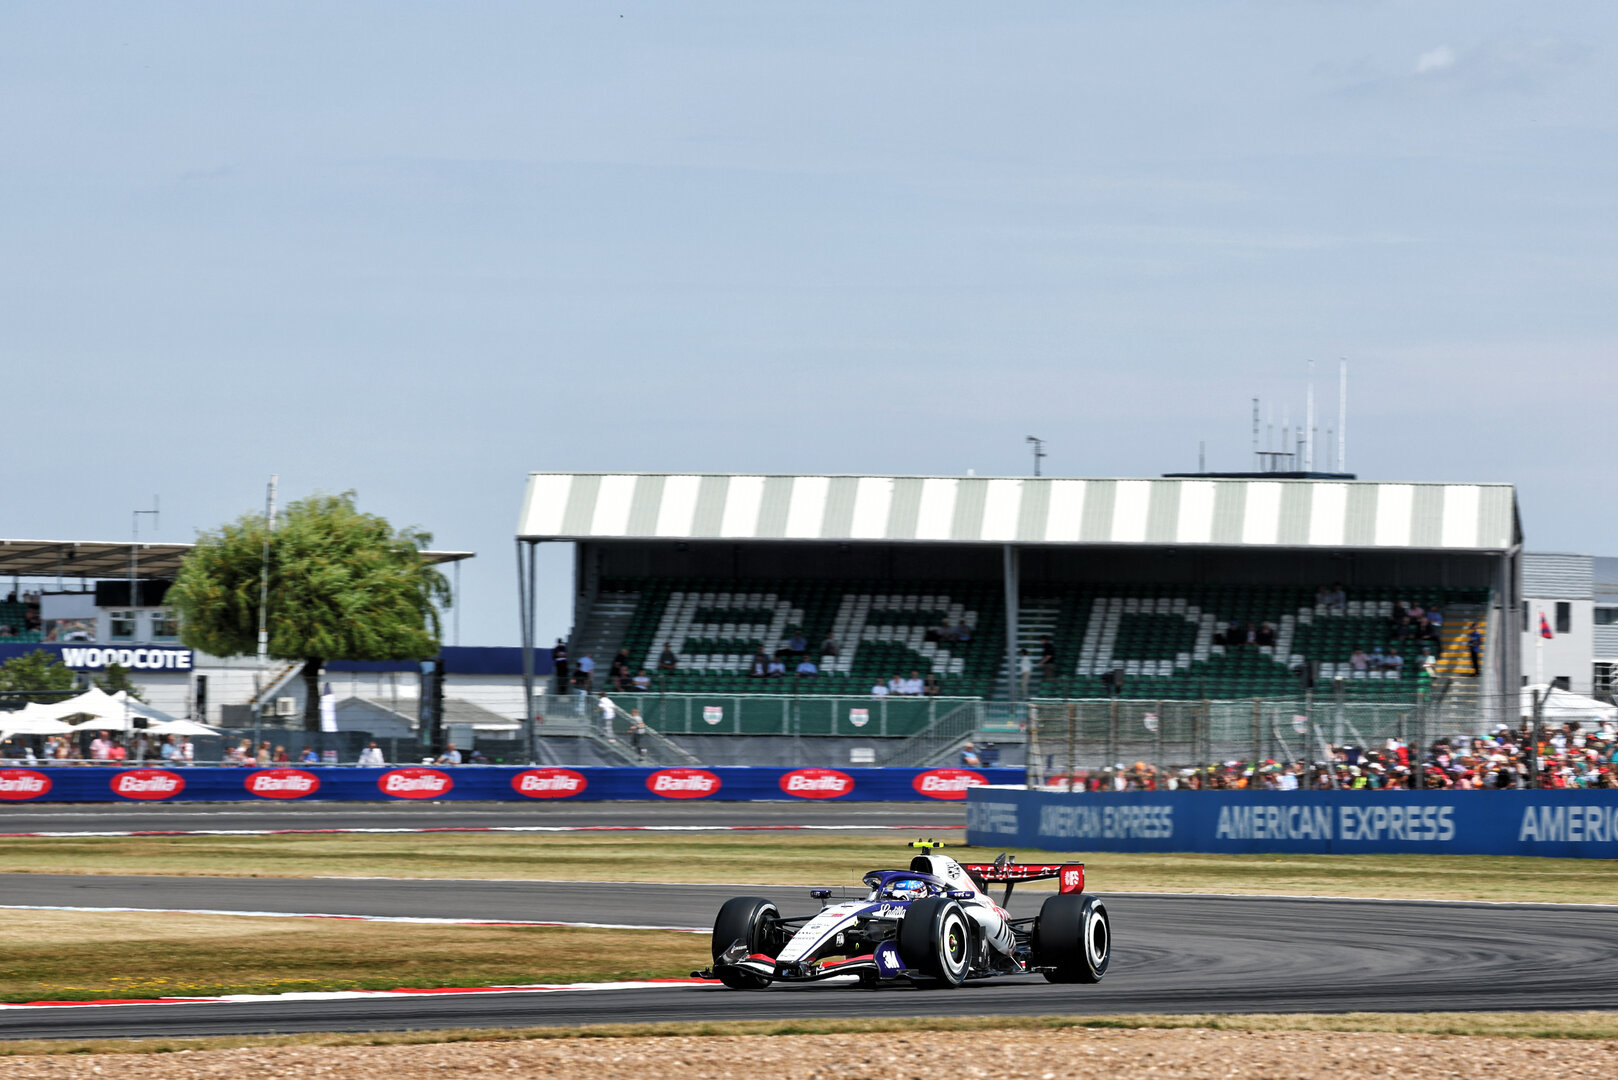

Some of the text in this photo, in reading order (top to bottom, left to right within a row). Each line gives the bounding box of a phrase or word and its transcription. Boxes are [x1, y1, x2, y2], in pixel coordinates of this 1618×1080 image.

[62, 647, 192, 669] WOODCOTE
[118, 776, 179, 791] Barilla
[252, 776, 314, 791] Barilla
[386, 775, 448, 791] Barilla
[520, 775, 581, 790] Barilla
[654, 775, 715, 791] Barilla
[787, 775, 848, 791] Barilla
[1103, 806, 1173, 839] EXPRESS
[1215, 805, 1455, 841] AMERICAN EXPRESS
[882, 950, 900, 969] 3M
